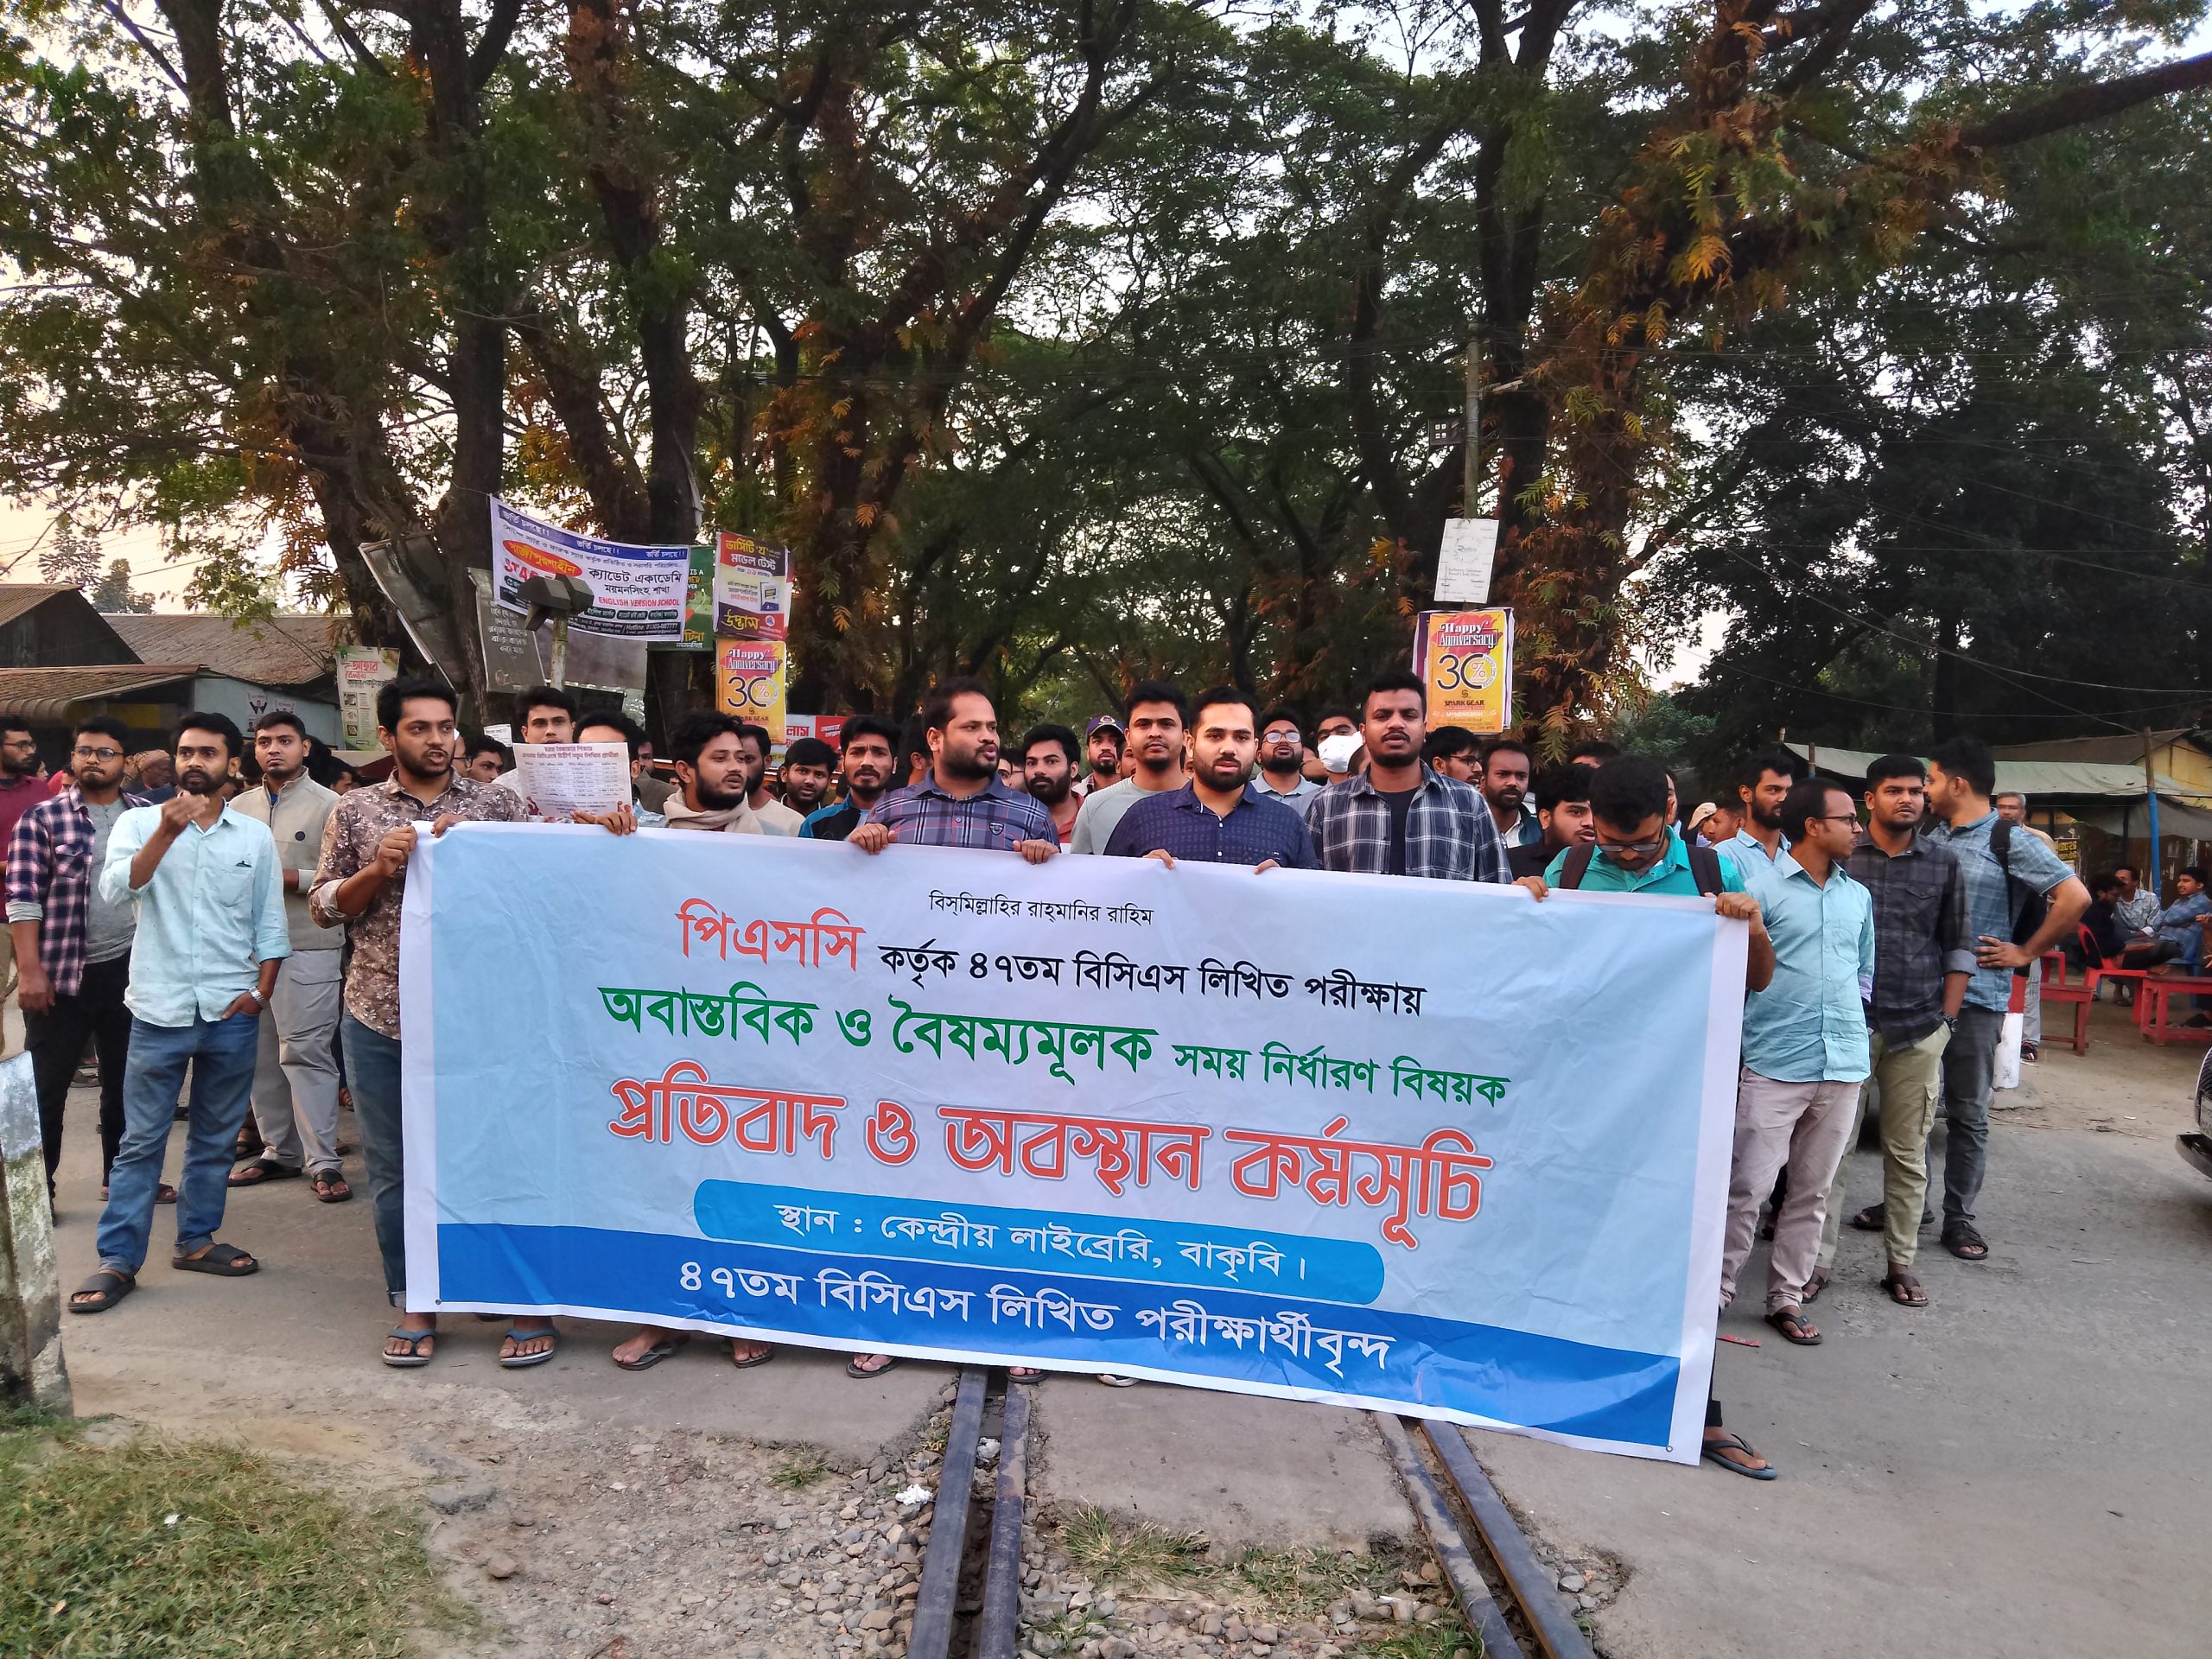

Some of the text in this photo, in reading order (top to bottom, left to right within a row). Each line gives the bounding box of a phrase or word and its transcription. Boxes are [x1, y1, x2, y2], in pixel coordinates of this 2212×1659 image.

[576, 540, 592, 550] ভর্তি
[726, 537, 754, 554] ভার্সিটি
[645, 550, 660, 558] ভর্তি
[731, 553, 756, 567] মডেল
[757, 556, 776, 570] টেস্ট
[588, 567, 682, 583] ক্যাডেট একাডেমি
[605, 584, 670, 595] ময়মনসিংহ শাখা
[598, 596, 628, 606] ENGLISH
[630, 598, 657, 607] VERSION
[721, 609, 760, 630] উদ্ভাস
[1440, 620, 1489, 633] Happy
[1440, 632, 1494, 648] Anniversary
[728, 649, 772, 659] Happy
[728, 658, 775, 672] Anniversary
[1107, 902, 1154, 925] রাহিম
[675, 899, 1427, 1017] পিএসসি কর্তৃক ৪৭তম বিসিএস লিখিত পরীক্ষায়
[597, 981, 1511, 1108] অবাস্তবিক ও বৈষম্যমূলক সময় নির্ধারণ বিষয়ক
[608, 1058, 1496, 1250] প্রতিবাদ ও অবস্থান কর্মসূচি
[772, 1204, 841, 1238] স্থান
[880, 1211, 999, 1250] কেন্দ্রীয়
[1007, 1220, 1163, 1269] লাইব্রেরি,
[1176, 1241, 1287, 1283] বাকৃবি
[679, 1261, 1397, 1379] ৪৭তম বিসিএস লিখিত পরীক্ষার্থীবৃন্দ
